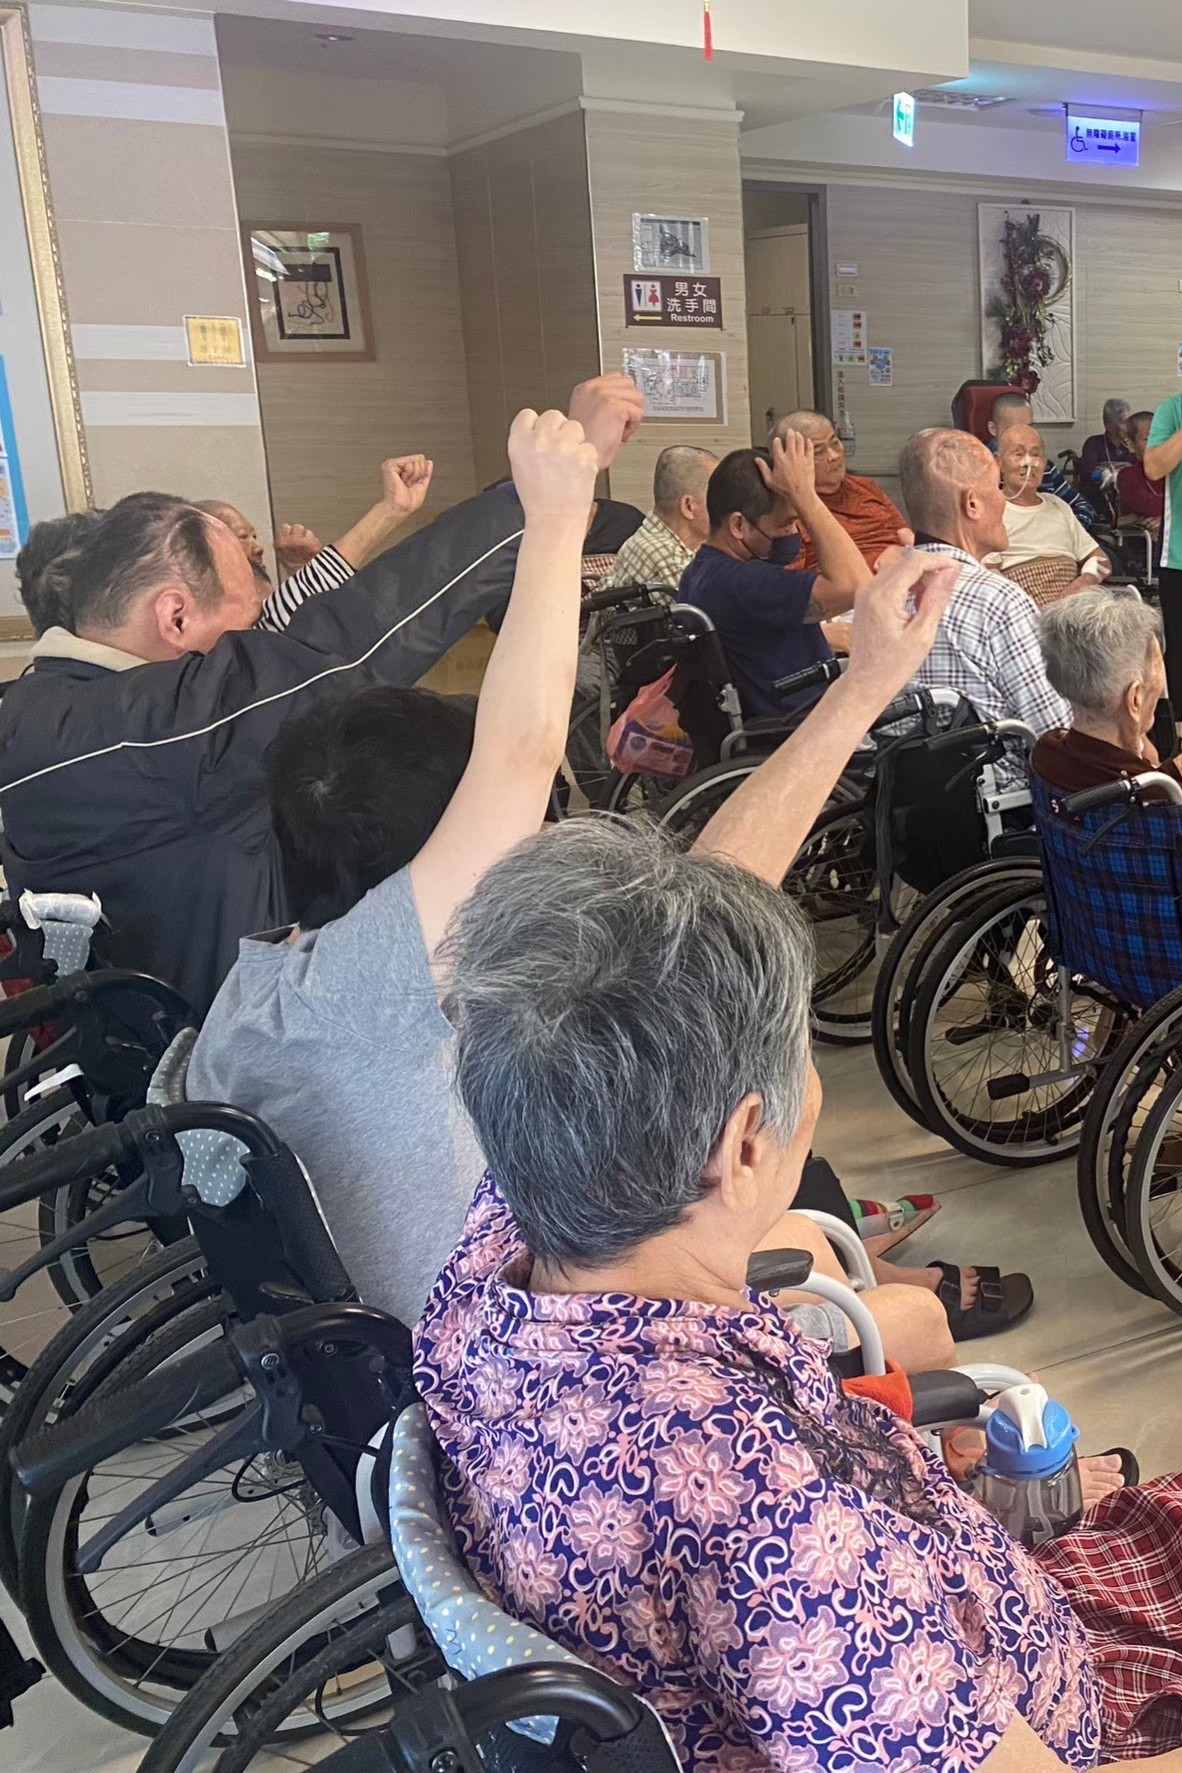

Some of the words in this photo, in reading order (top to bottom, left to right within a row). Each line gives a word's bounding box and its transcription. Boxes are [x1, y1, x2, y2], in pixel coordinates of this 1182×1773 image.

[674, 281, 707, 297] 男女
[667, 297, 717, 313] 洗手間
[670, 313, 714, 323] Restroom
